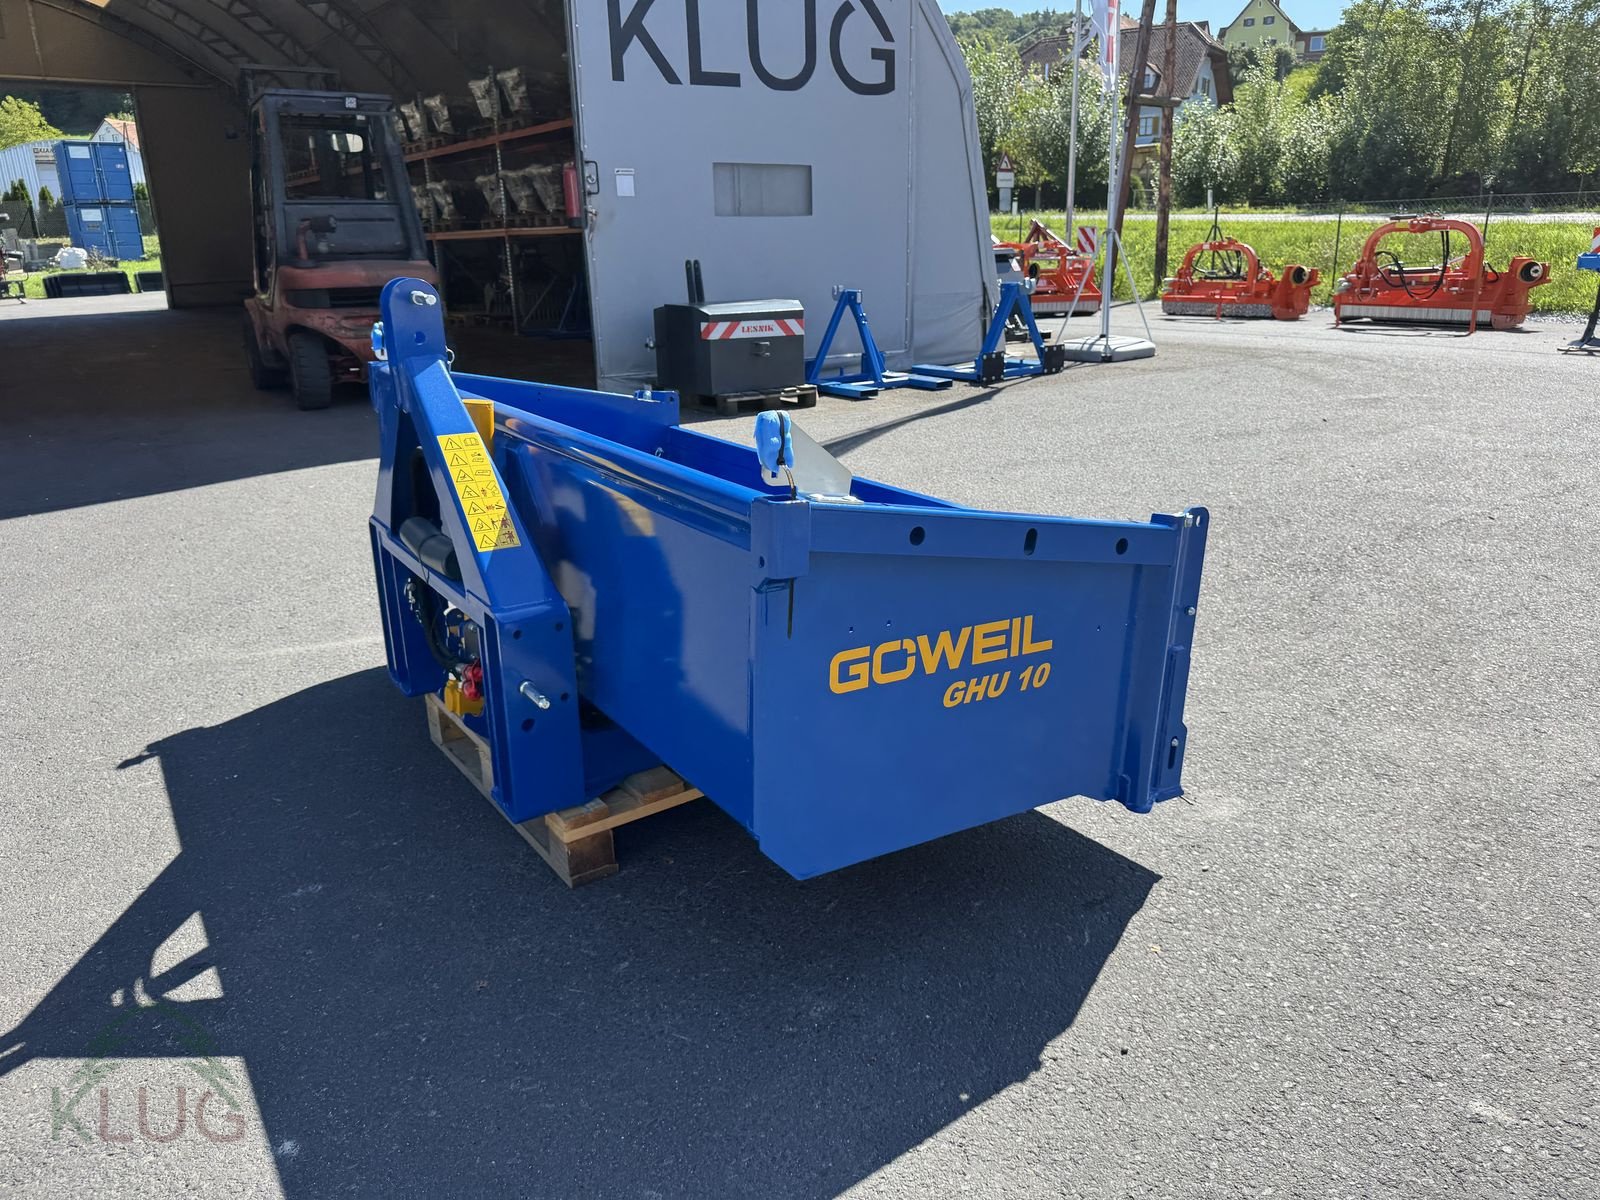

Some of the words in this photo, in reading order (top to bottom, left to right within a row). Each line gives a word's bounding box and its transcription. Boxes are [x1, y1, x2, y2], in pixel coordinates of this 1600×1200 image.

[607, 0, 896, 96] KLUG
[943, 670, 1012, 708] GHU
[1018, 662, 1052, 692] 10
